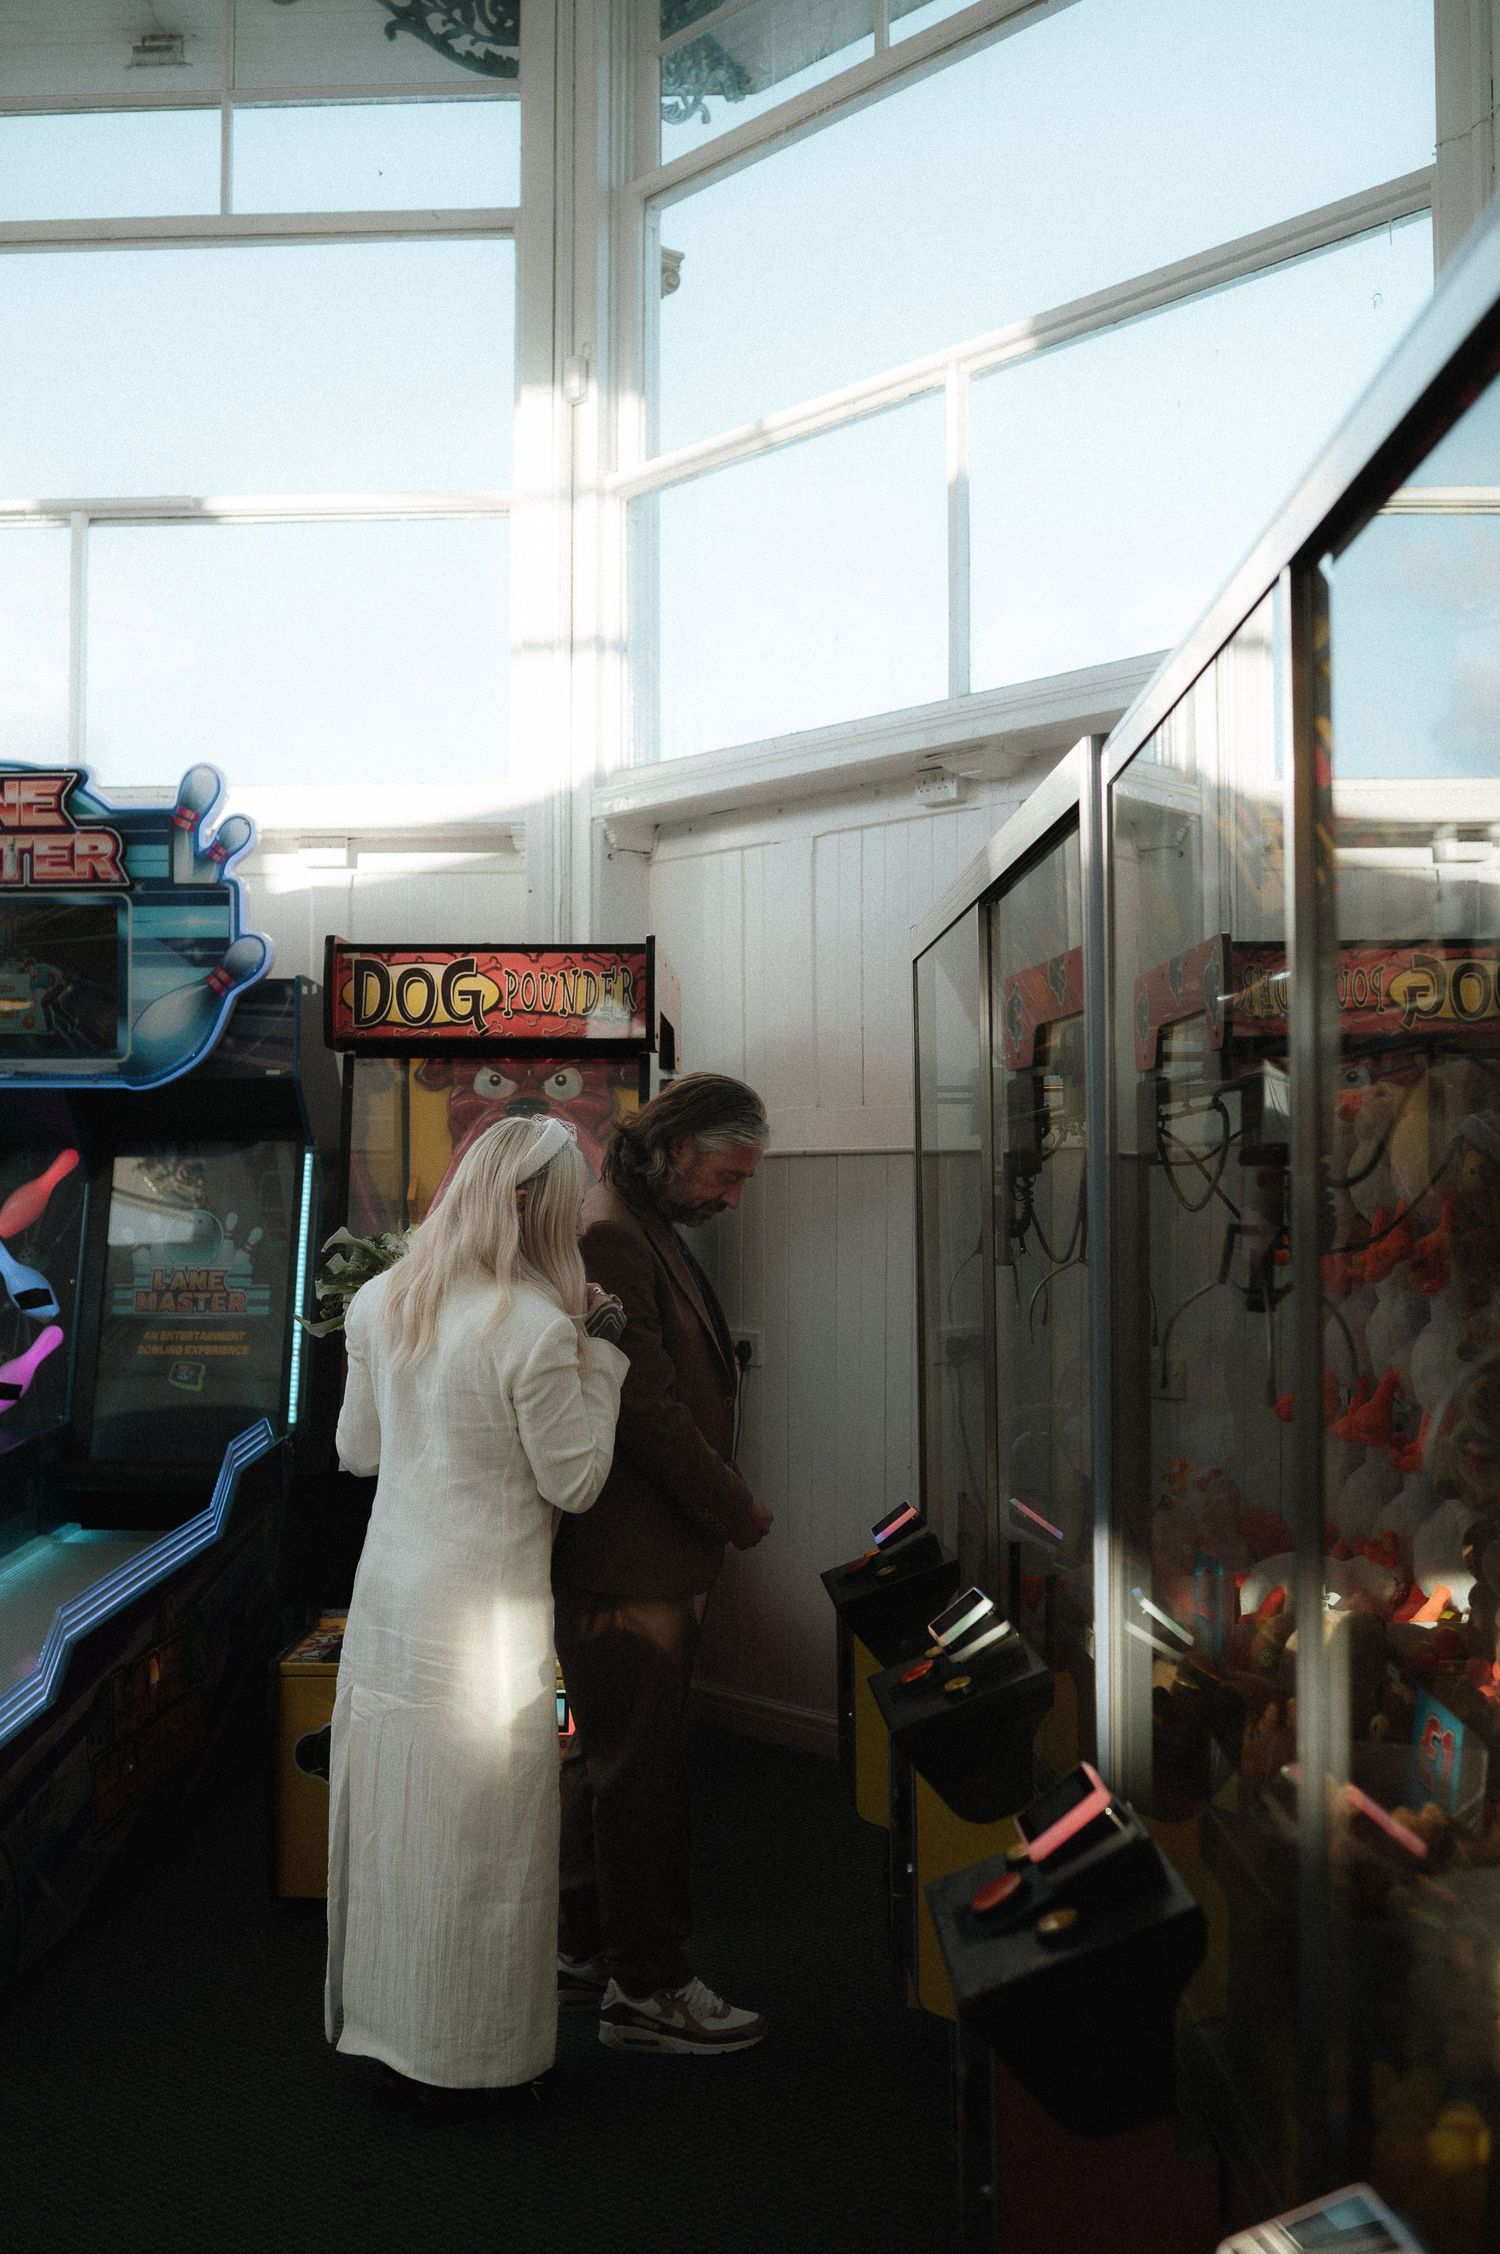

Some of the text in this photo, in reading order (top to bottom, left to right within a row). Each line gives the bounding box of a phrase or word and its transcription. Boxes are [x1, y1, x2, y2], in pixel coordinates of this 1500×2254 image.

[353, 957, 637, 1035] DOG POUNDER
[152, 1269, 227, 1290] LANE
[135, 1291, 247, 1313] MASTER
[137, 1344, 250, 1356] BOWLING EXPERIENCE
